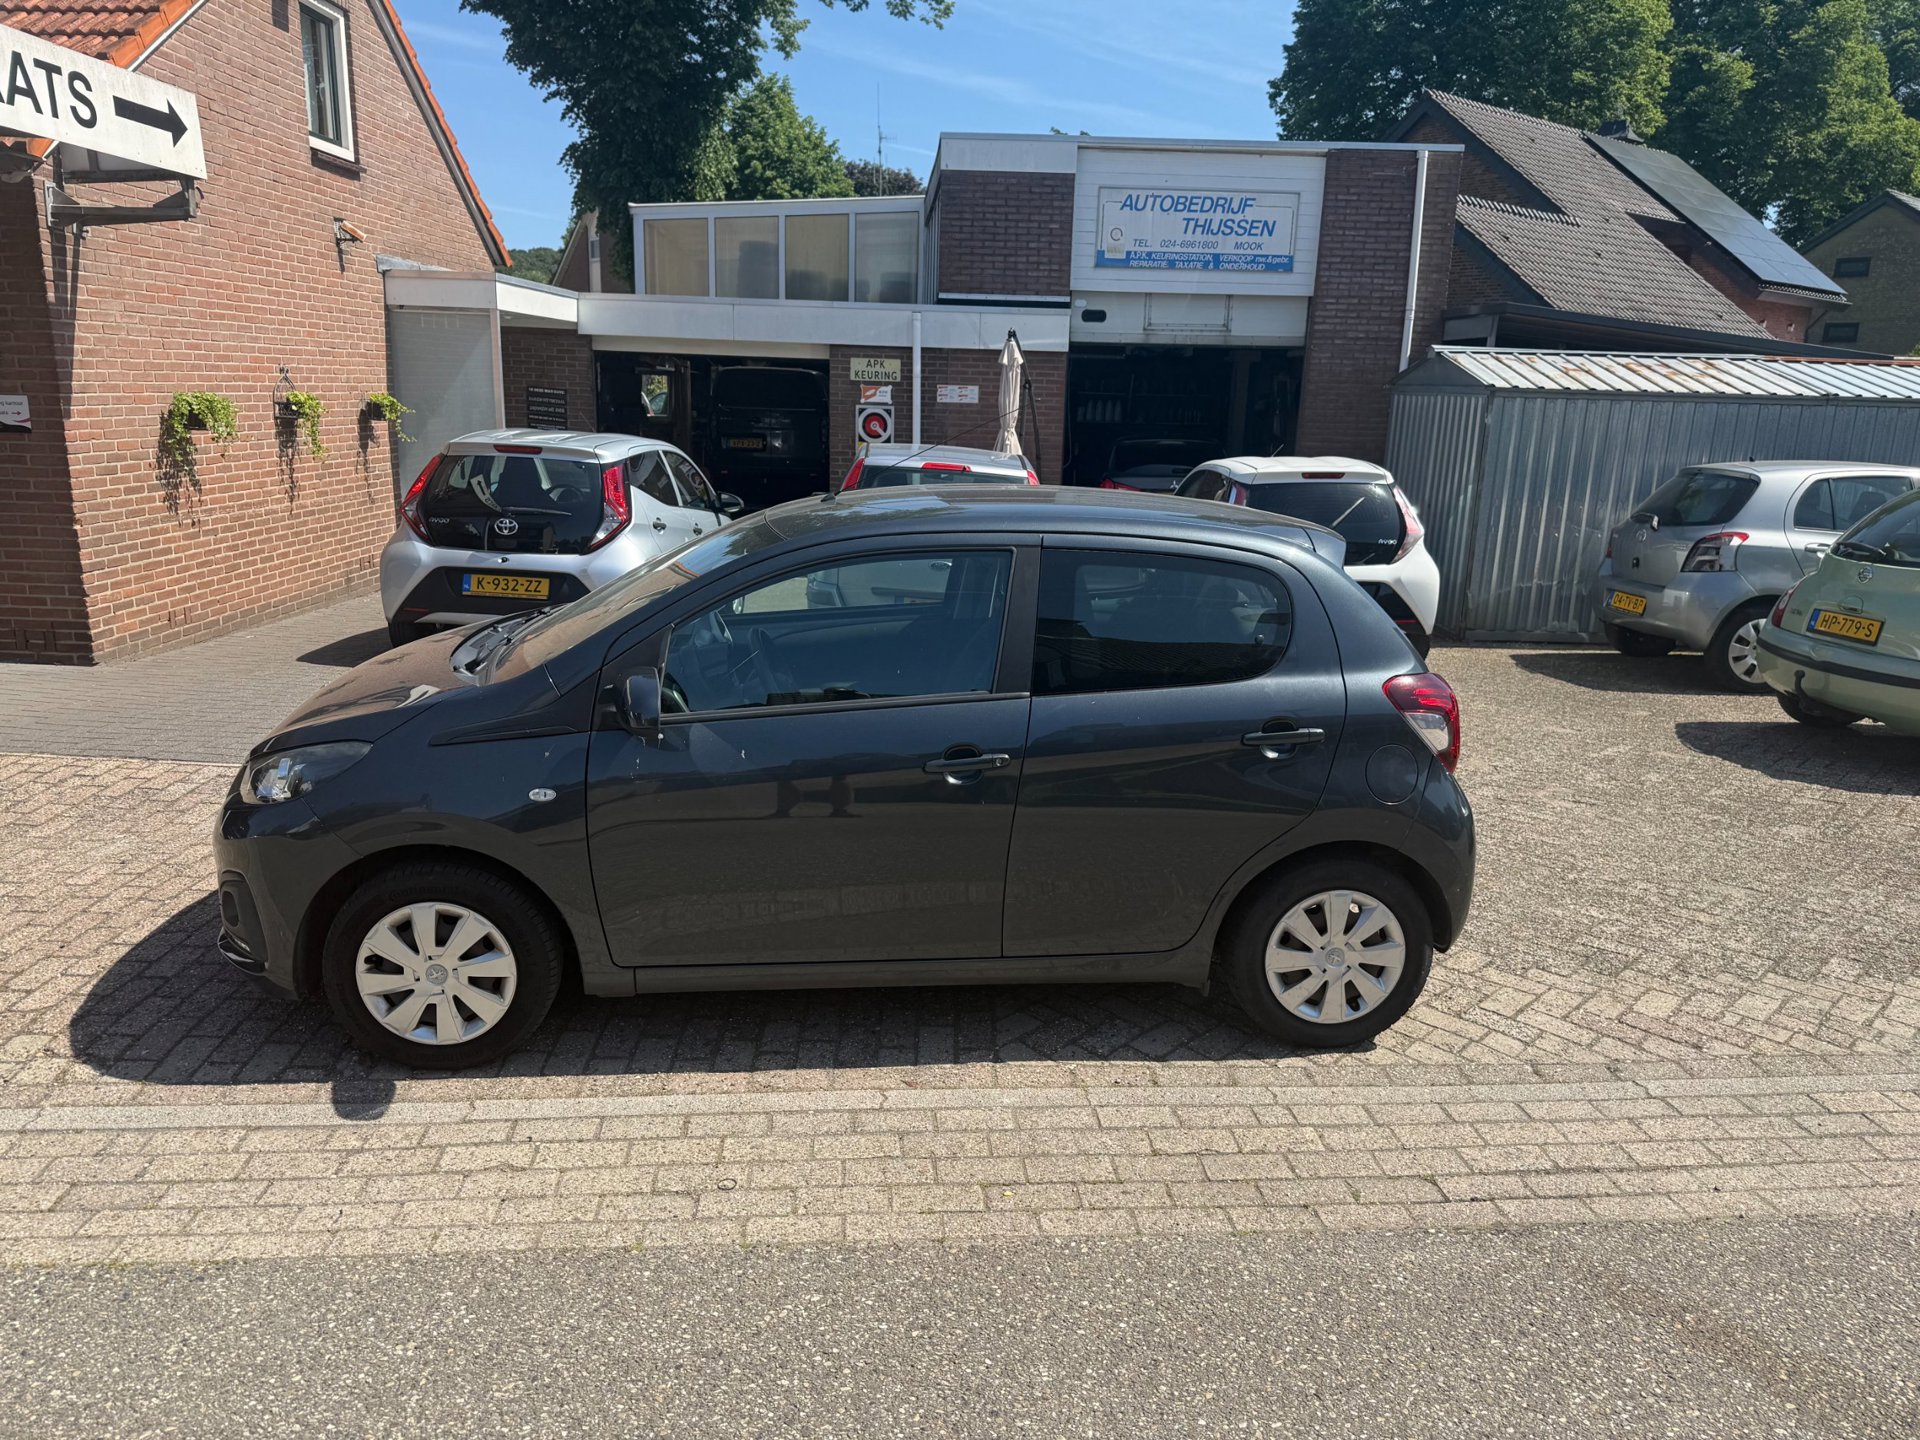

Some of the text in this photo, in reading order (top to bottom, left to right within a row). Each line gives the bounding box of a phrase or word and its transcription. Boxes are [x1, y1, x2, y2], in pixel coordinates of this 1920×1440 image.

[0, 50, 98, 129] ATS
[1119, 193, 1256, 214] AUTOBEDRIJF
[1182, 217, 1276, 237] THIJSSEN
[1133, 239, 1264, 251] TEL. 024-6961800 MOOK
[1219, 254, 1254, 262] VERKOOP
[866, 360, 885, 369] APK
[854, 370, 898, 380] KEURING
[476, 577, 542, 593] K-932-ZZ
[1820, 614, 1874, 637] HP-779-S
